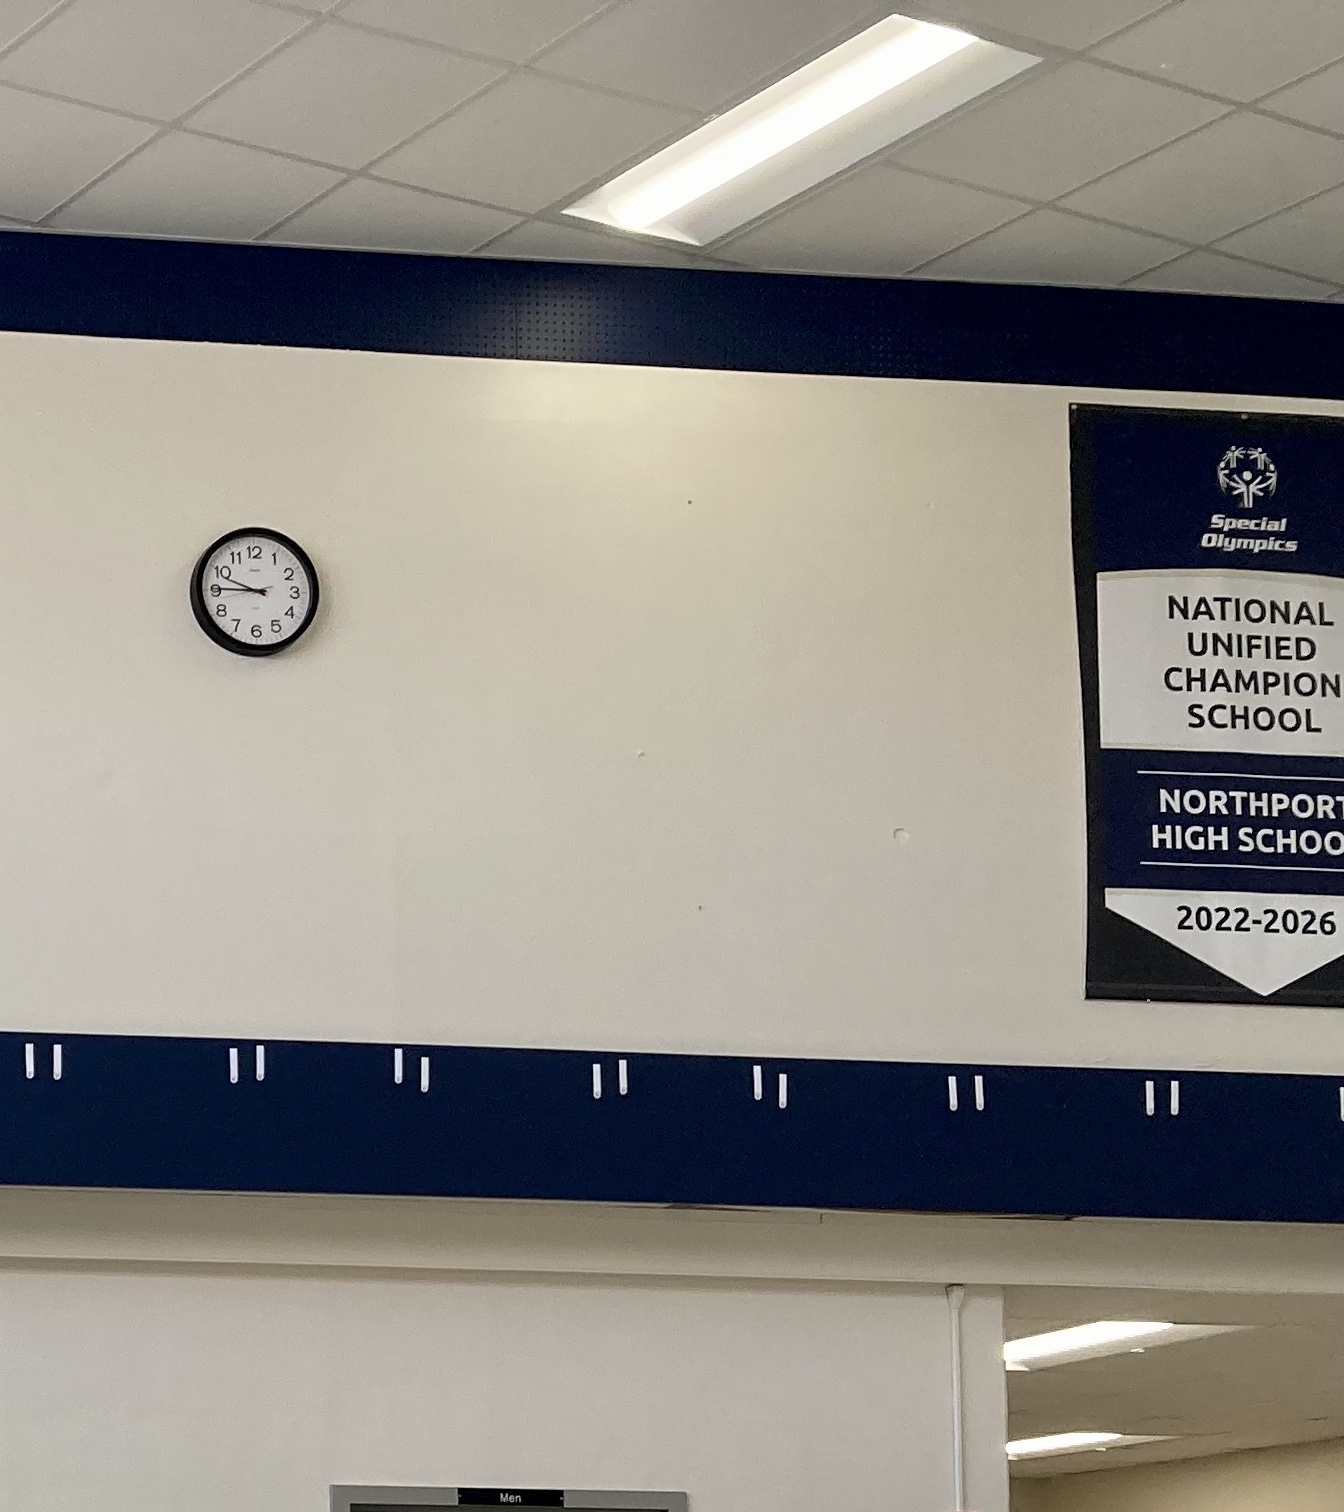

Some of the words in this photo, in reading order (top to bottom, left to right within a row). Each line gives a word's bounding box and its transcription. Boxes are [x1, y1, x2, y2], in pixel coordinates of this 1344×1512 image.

[1210, 513, 1287, 532] Special
[1201, 532, 1299, 553] Olympics
[229, 551, 242, 565] 11
[246, 545, 262, 559] 12
[214, 565, 232, 579] 10
[283, 567, 294, 581] 2
[289, 586, 300, 600] 3
[216, 603, 227, 617] 8
[284, 605, 295, 619] 4
[1168, 595, 1335, 626] NATIONAL
[231, 618, 241, 632] 7
[251, 624, 262, 638] 6
[271, 619, 282, 633] 5
[1187, 632, 1317, 661] UNIFIED
[1164, 666, 1341, 698] CHAMPION
[1187, 703, 1322, 733] SCHOOL
[1151, 824, 1228, 851] HIGH
[1176, 905, 1337, 935] 2022-2026
[499, 1492, 522, 1503] Men
